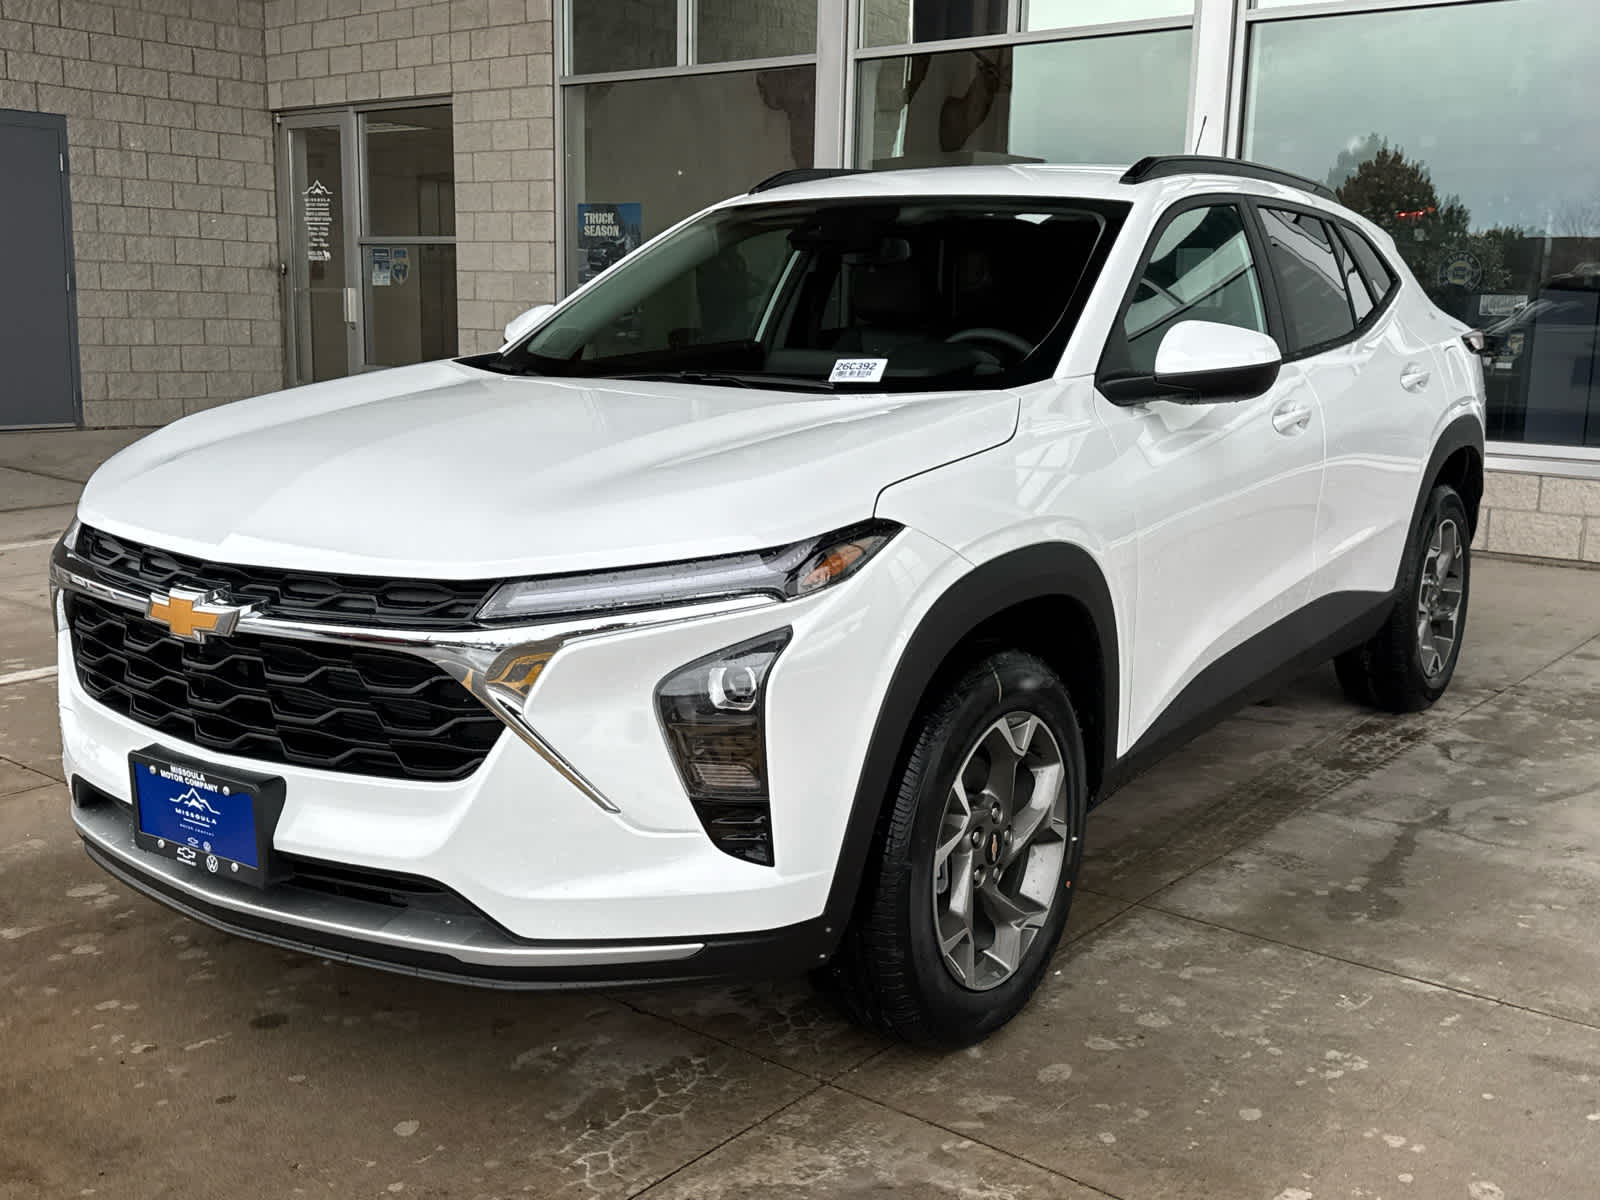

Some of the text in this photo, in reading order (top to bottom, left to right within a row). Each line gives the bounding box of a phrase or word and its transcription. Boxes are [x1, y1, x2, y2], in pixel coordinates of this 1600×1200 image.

[583, 212, 615, 225] TRUCK
[583, 225, 620, 237] SEASON
[835, 362, 878, 371] 26C392
[170, 764, 206, 782] MISSOULA
[160, 769, 218, 793] MOTOR COMPANY
[175, 807, 217, 825] MISSOULA
